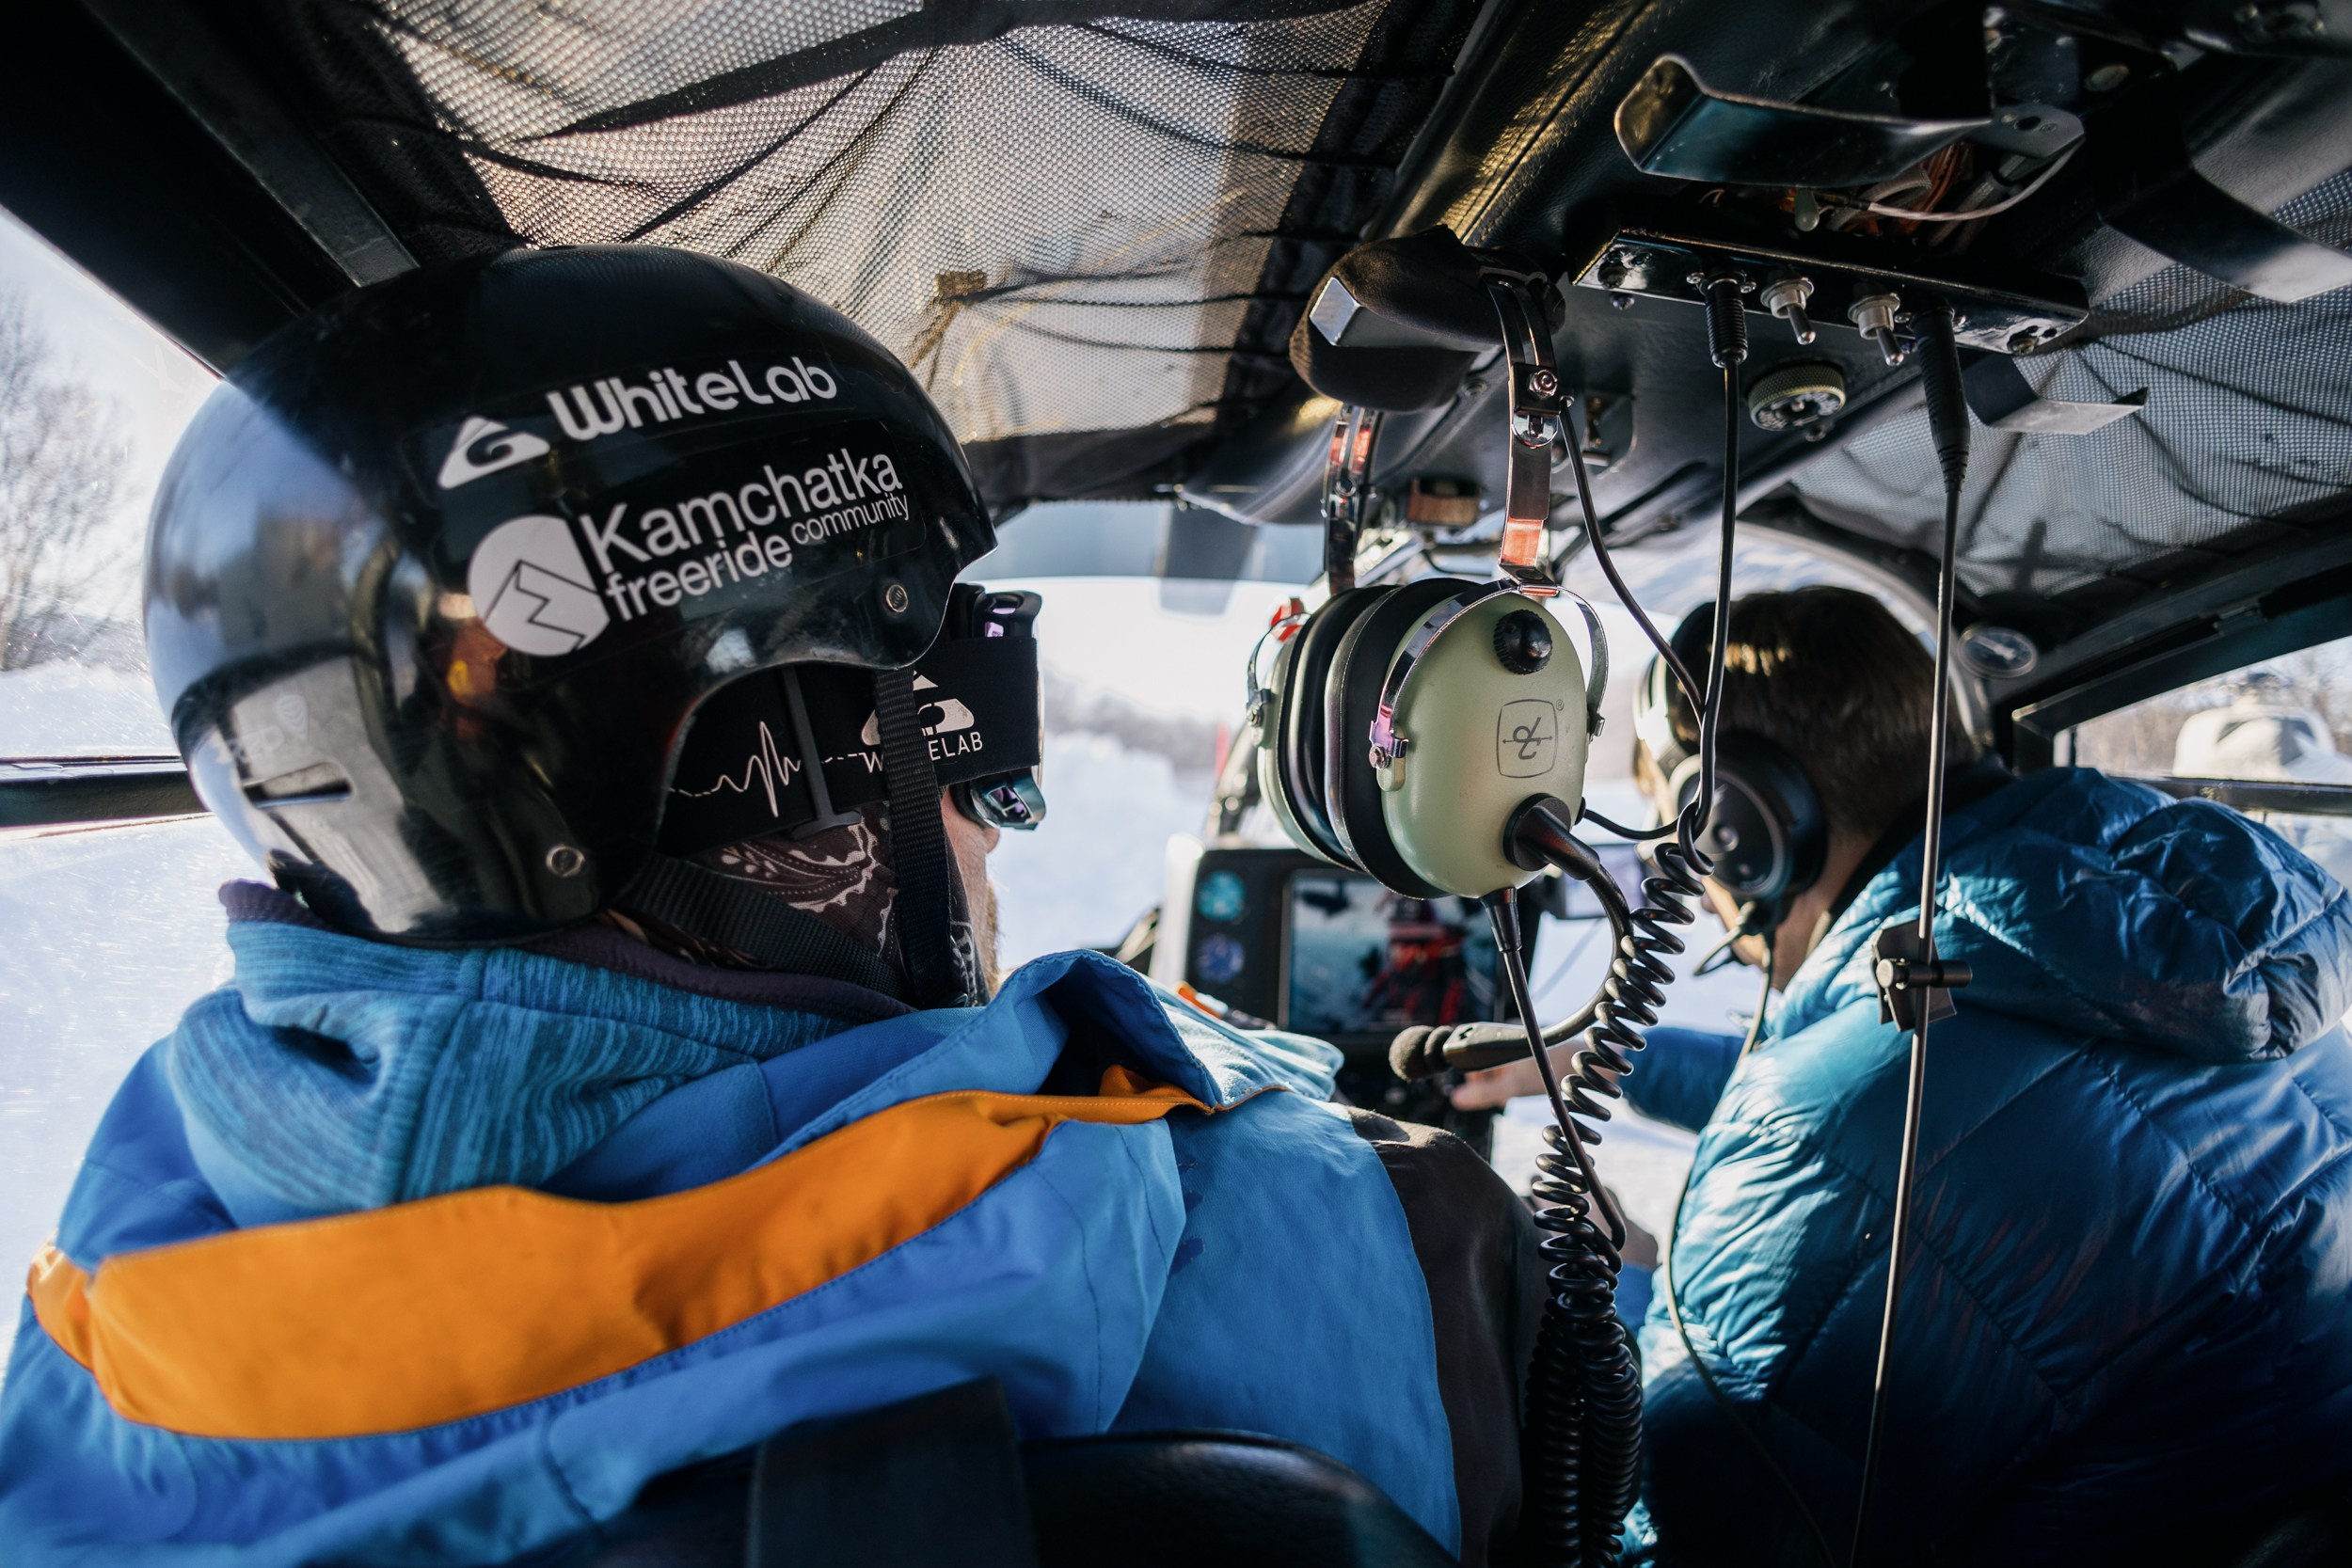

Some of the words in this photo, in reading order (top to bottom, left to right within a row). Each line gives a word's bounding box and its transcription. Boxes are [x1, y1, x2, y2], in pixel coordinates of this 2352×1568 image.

[547, 356, 837, 441] WhiteLab
[580, 448, 903, 575] Kamchatka
[605, 531, 792, 622] freeride
[790, 493, 908, 546] community
[860, 731, 984, 774] WELAB
